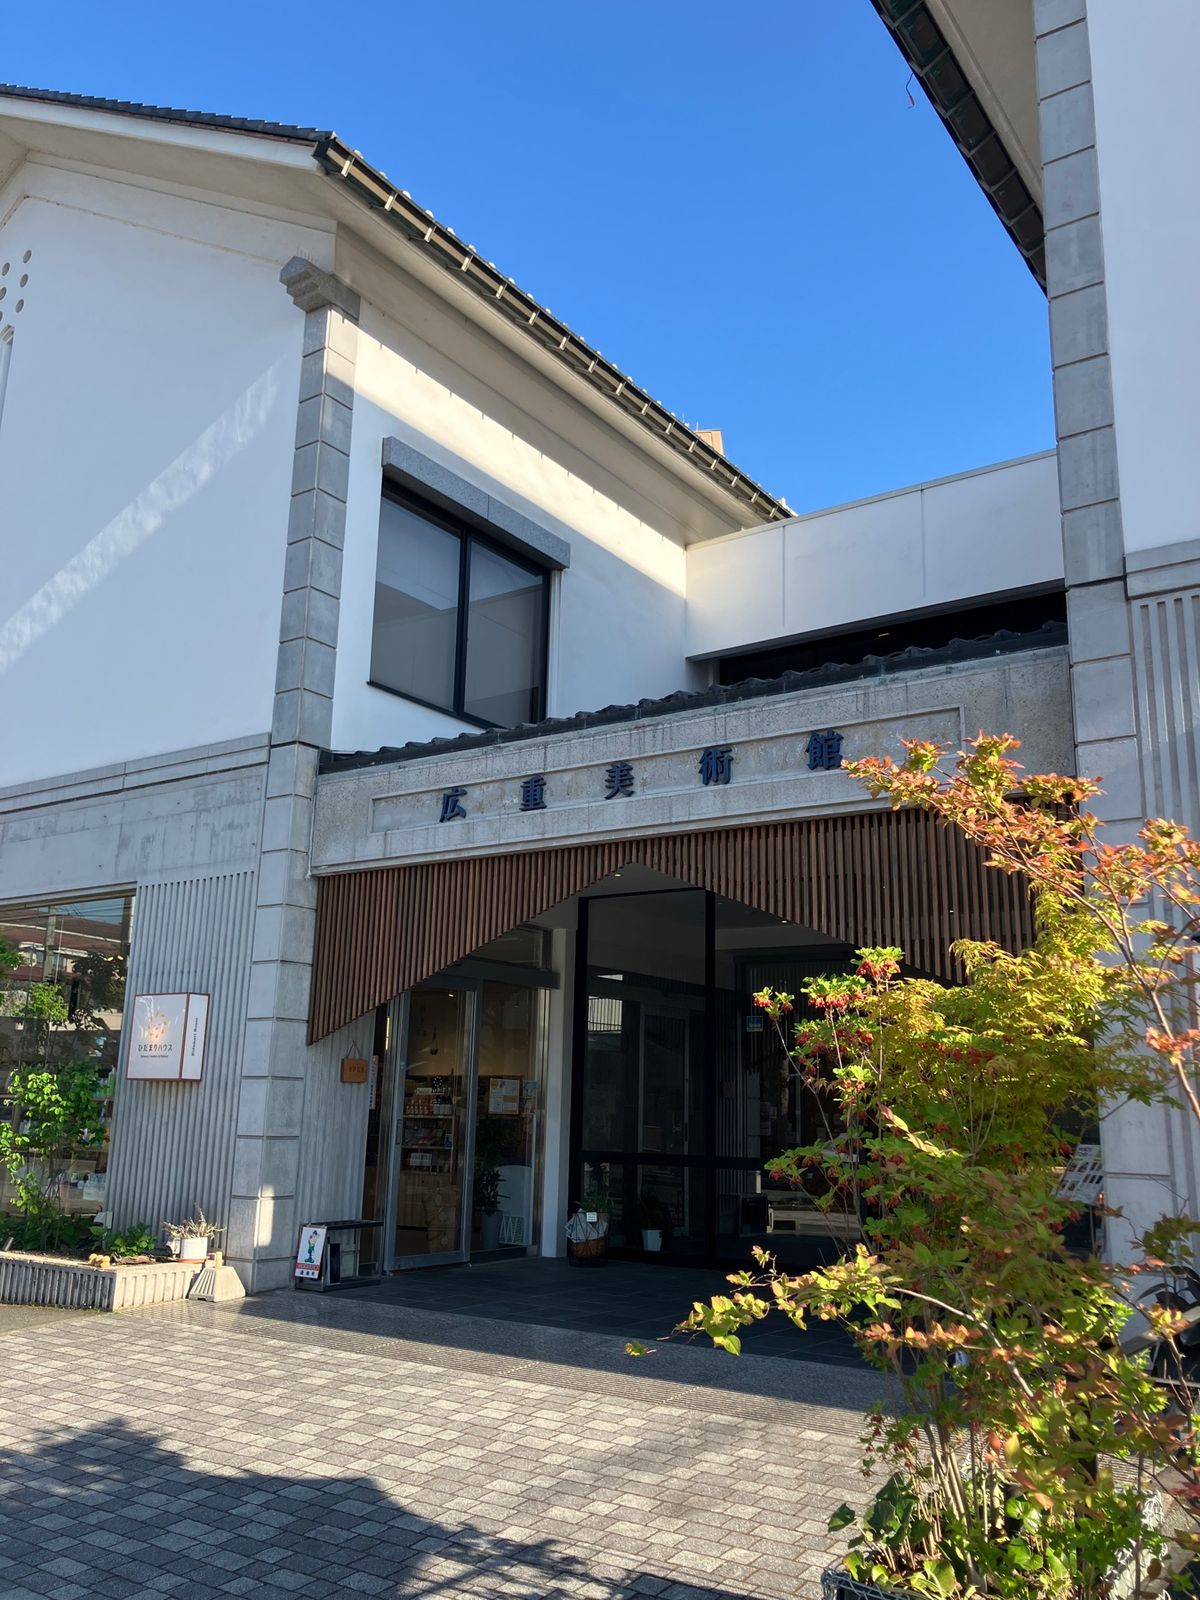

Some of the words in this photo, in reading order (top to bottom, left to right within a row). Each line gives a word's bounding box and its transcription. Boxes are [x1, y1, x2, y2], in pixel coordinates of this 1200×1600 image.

[439, 729, 845, 823] 広重美術館
[138, 1044, 173, 1052] ひだまりハウス
